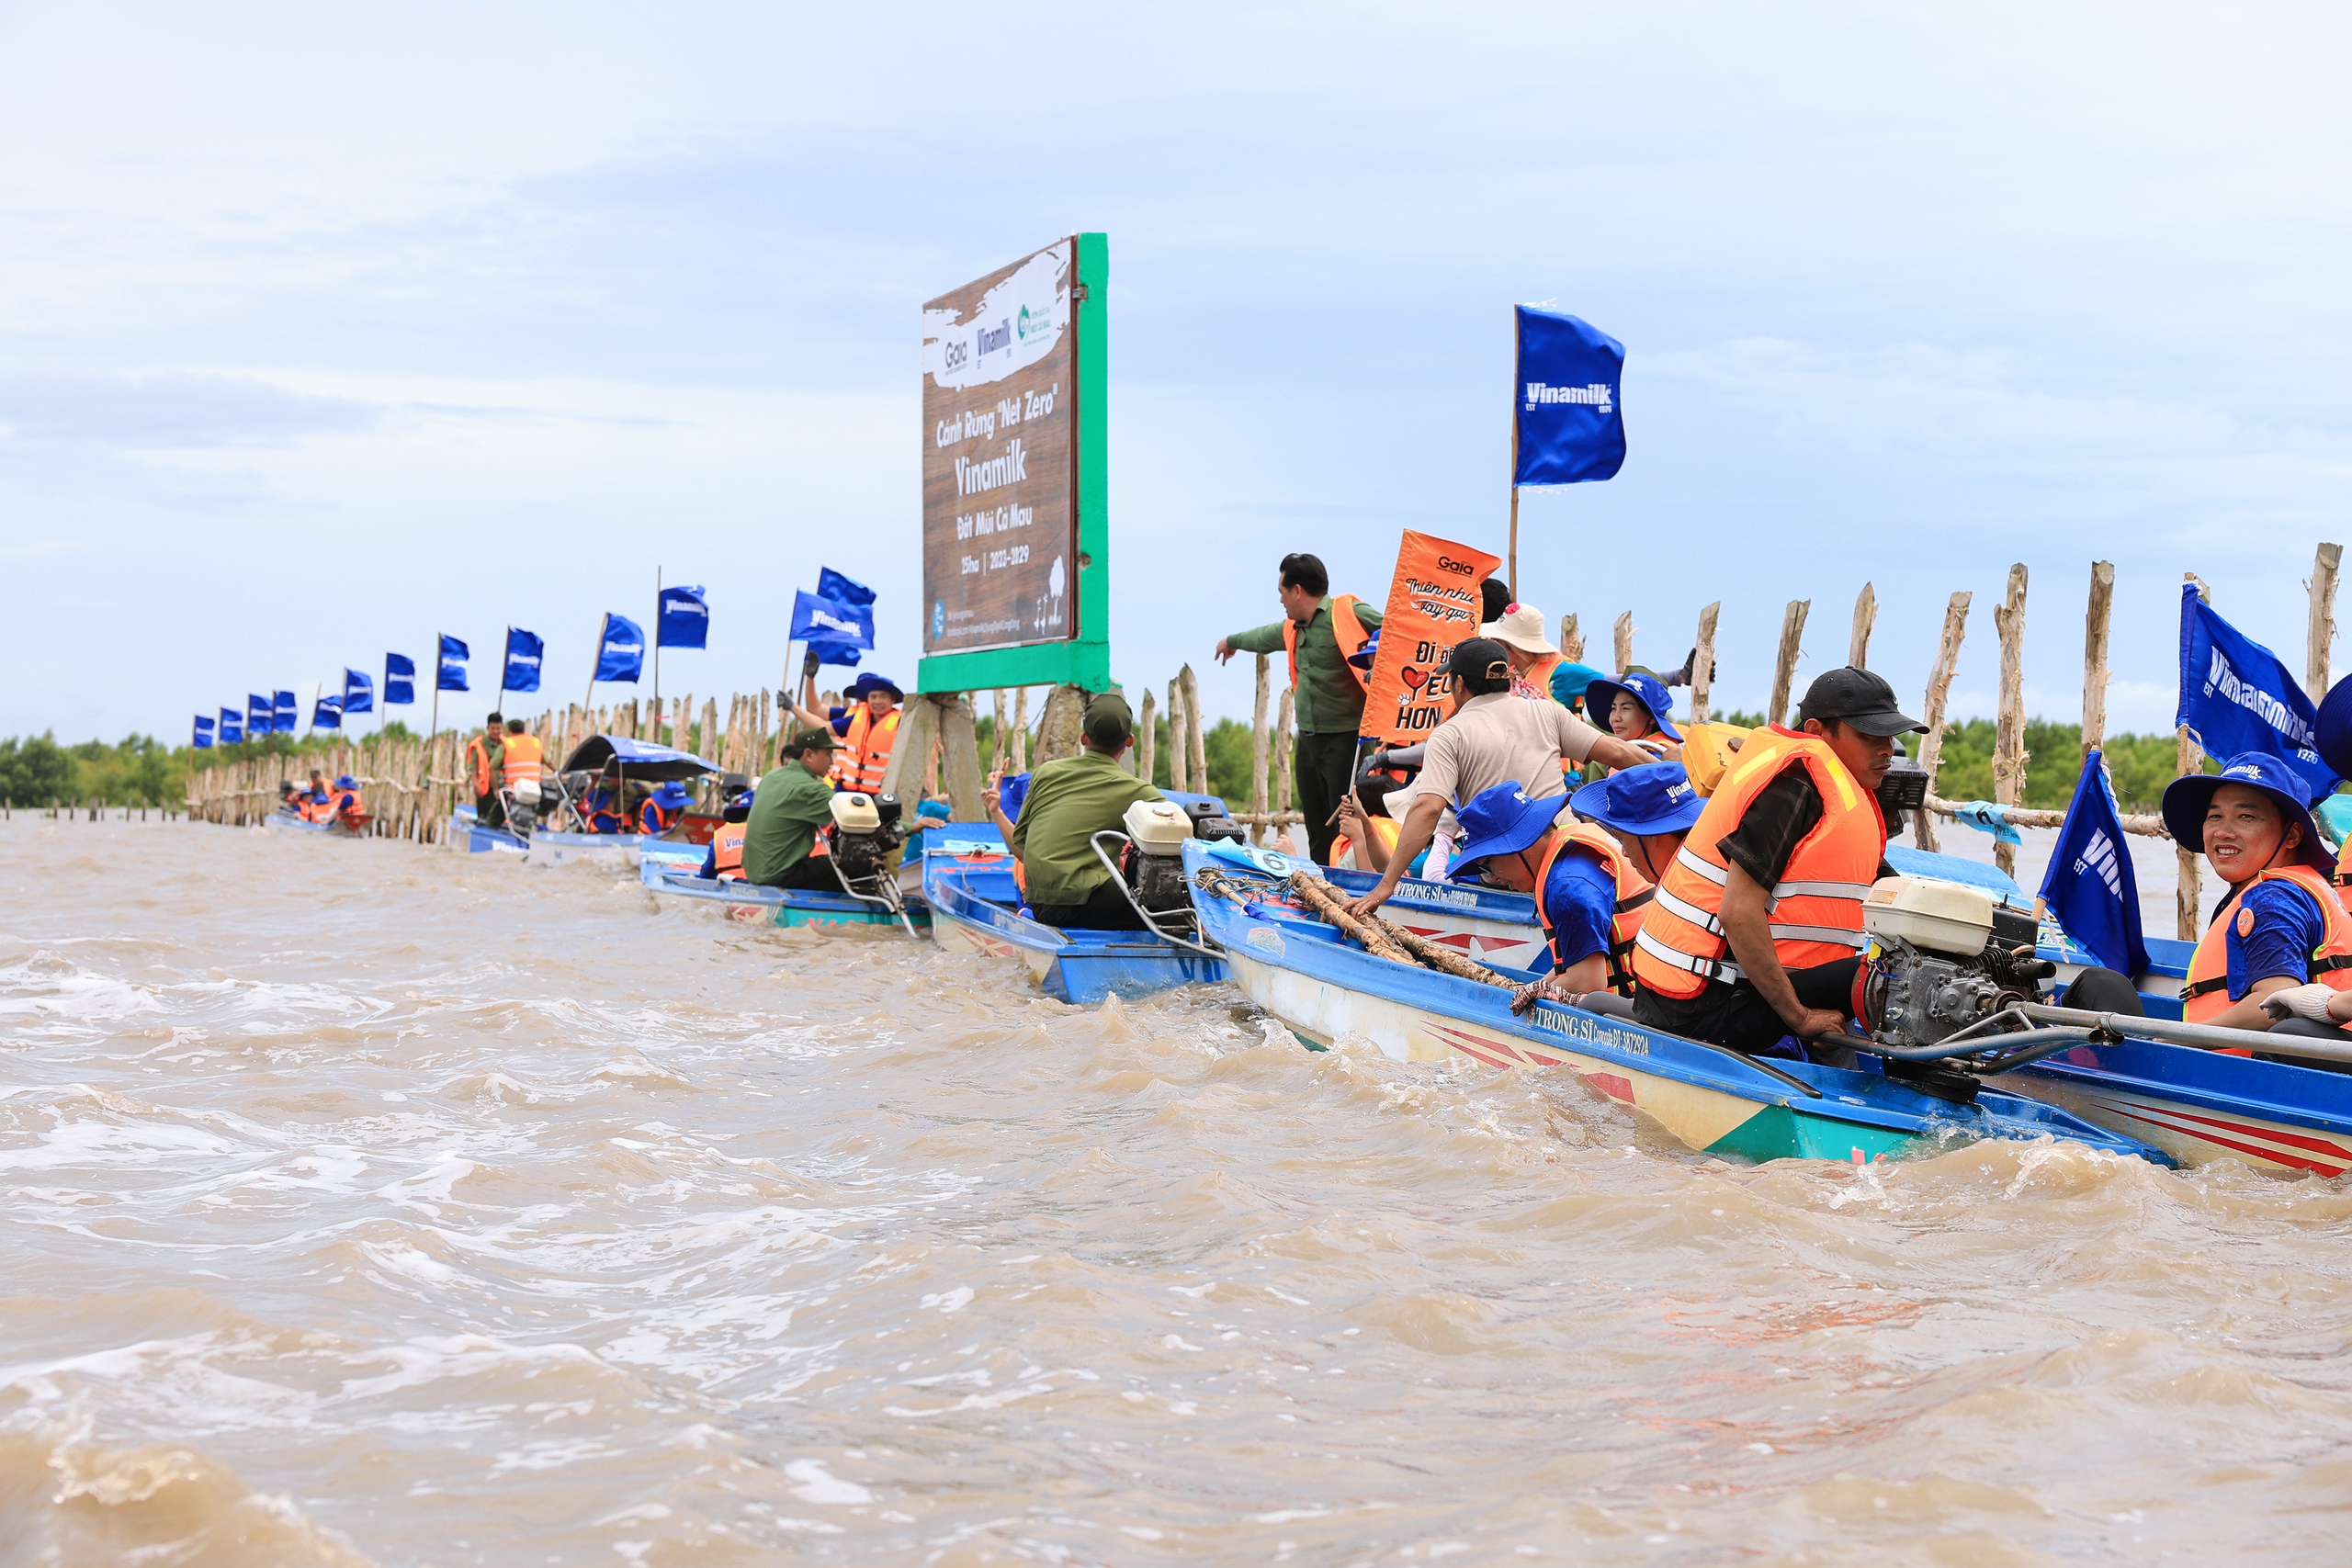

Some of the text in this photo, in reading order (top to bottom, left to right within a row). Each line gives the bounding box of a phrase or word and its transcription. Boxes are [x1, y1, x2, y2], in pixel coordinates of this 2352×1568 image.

[1526, 382, 1612, 405] Vinamilk
[1525, 403, 1612, 413] EST 1976
[936, 413, 963, 448] Cánh
[965, 409, 995, 440] Rừng
[955, 438, 1027, 496] Vinamilk
[996, 506, 1009, 532] Cà
[1010, 502, 1033, 528] Mau
[1439, 556, 1475, 576] Gaia
[2203, 682, 2214, 698] EST
[2074, 858, 2089, 875] EST
[2082, 827, 2124, 903] Vin
[1580, 1019, 1594, 1043] SĨ
